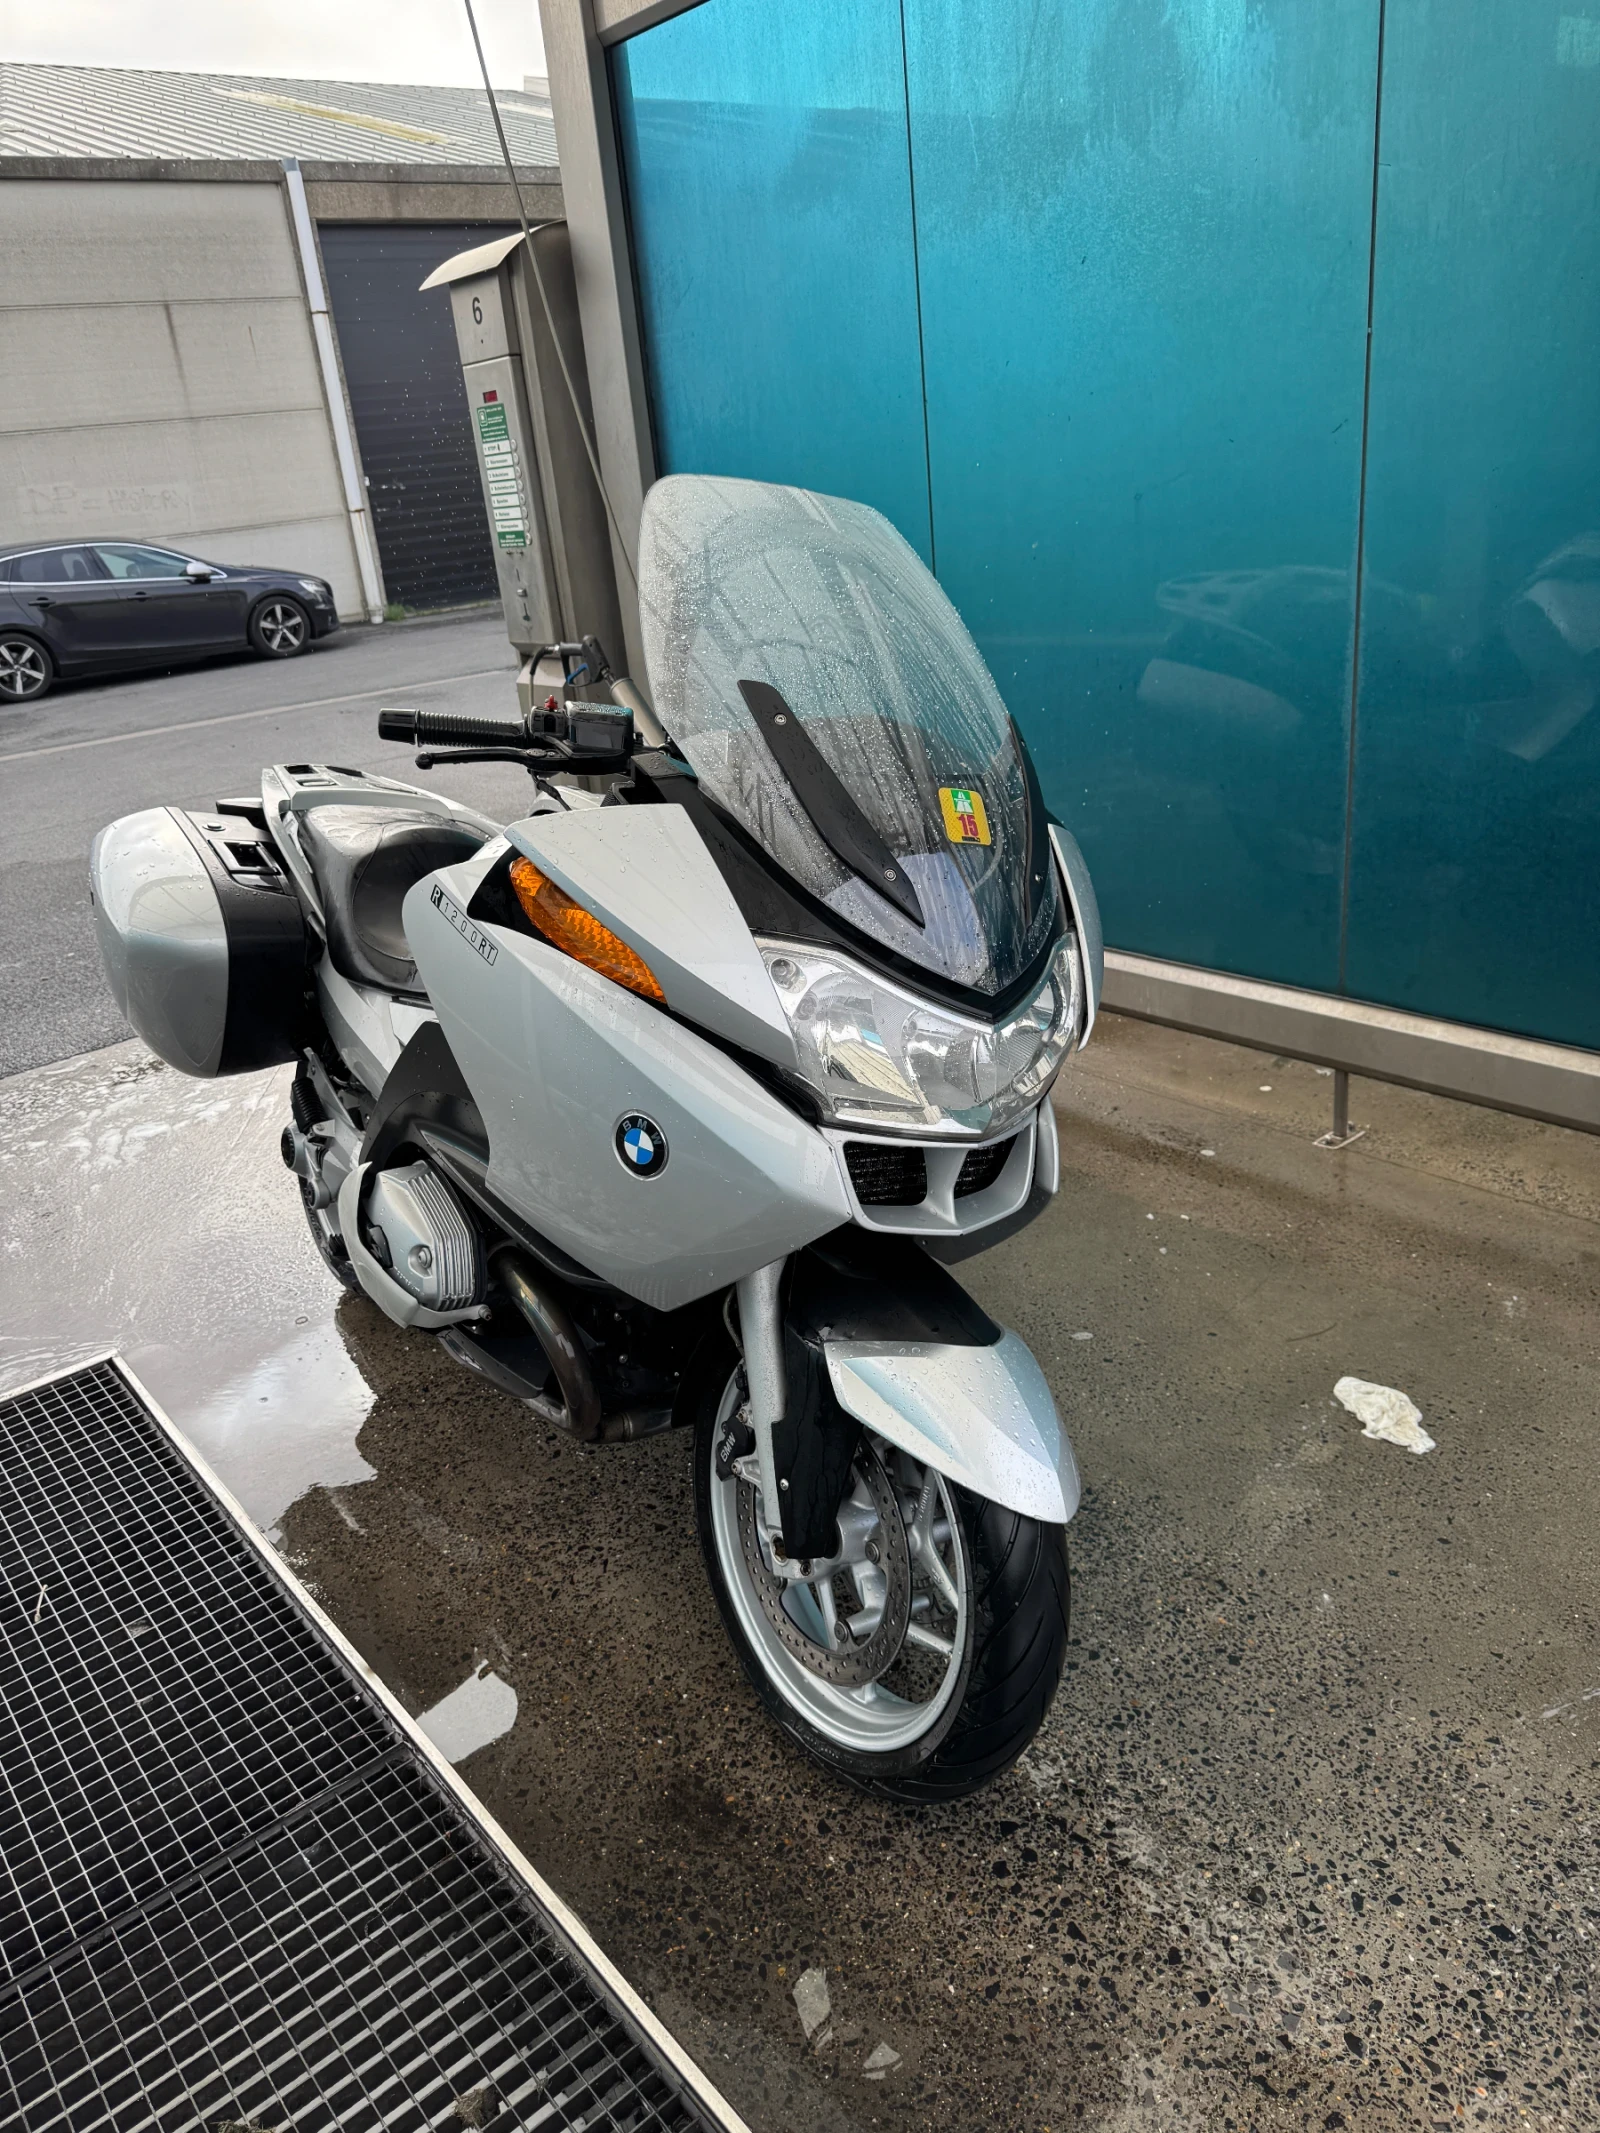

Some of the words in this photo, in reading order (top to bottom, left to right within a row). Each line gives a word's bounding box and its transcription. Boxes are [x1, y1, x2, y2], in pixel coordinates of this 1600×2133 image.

[472, 296, 483, 326] 6
[957, 813, 979, 837] 15
[622, 1118, 662, 1145] BMW
[720, 1432, 736, 1462] BMW
